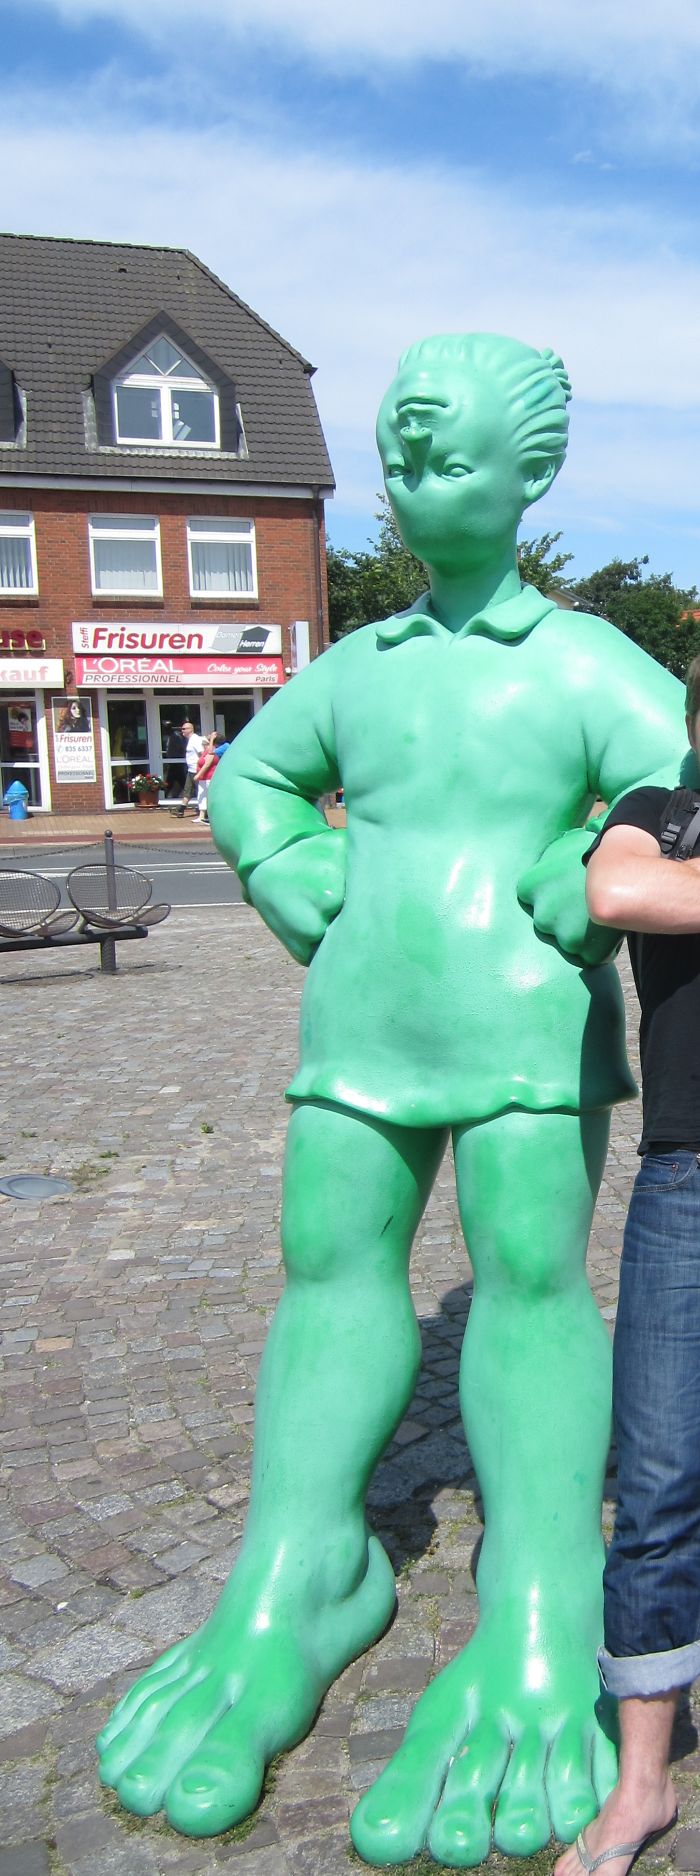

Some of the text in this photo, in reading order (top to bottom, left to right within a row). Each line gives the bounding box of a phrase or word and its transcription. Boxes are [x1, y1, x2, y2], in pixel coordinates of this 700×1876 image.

[79, 626, 90, 649] Steffi
[92, 627, 203, 650] Frisuren
[239, 640, 265, 648] Herren
[82, 657, 184, 674] L'ORÉAL
[233, 666, 253, 675] your
[255, 663, 278, 675] Style
[85, 674, 276, 683] PROFESSIONNEL Paris
[60, 734, 93, 743] Frisuren
